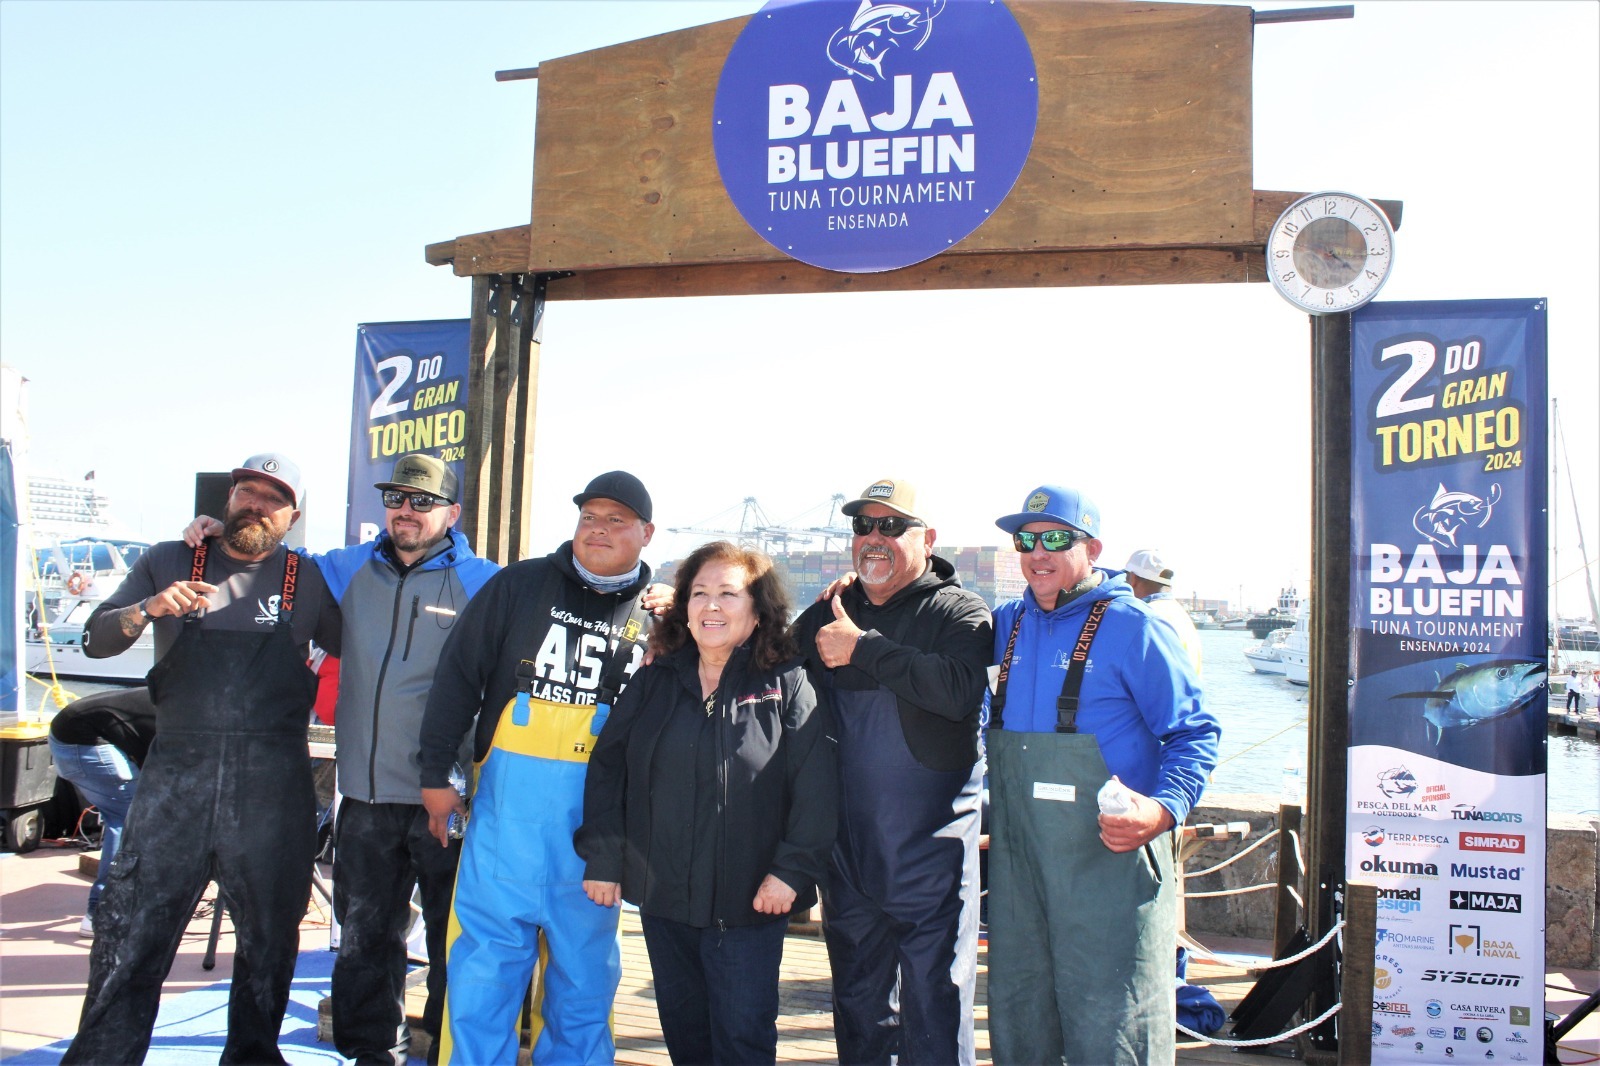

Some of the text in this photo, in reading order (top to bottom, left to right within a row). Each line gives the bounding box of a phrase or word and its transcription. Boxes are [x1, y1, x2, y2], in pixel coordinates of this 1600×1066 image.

[768, 72, 974, 140] BAJA
[767, 134, 975, 184] BLUEFIN
[768, 180, 976, 212] TUNA TOURNAMENT
[1324, 200, 1337, 215] 12
[828, 212, 909, 231] ENSENADA
[1281, 222, 1299, 238] 10
[1365, 269, 1379, 280] 4
[1301, 284, 1312, 299] 7
[1325, 291, 1334, 306] 6
[1347, 284, 1360, 299] 5
[370, 355, 443, 420] 2 DO
[1376, 340, 1481, 419] 2 DO
[413, 380, 460, 411] GRAN
[1442, 371, 1508, 409] GRAN
[369, 409, 466, 460] TORNEO
[1375, 406, 1520, 466] TORNEO
[440, 446, 466, 462] 2024
[1484, 450, 1522, 472] 2024
[1370, 543, 1522, 585] BAJA
[1370, 587, 1523, 617] BLUEFIN
[1370, 620, 1524, 638] TUNA TOURNAMENT
[1400, 640, 1491, 653] ENSENADA 2024
[531, 680, 572, 704] LASS
[1357, 801, 1438, 812] PESCA DEL MAR
[1421, 793, 1451, 803] SPONSORS
[1377, 810, 1417, 818] OUTDOORS
[1451, 810, 1523, 824] TUNABOATS
[1387, 833, 1450, 844] TERRAPESCA
[1464, 836, 1520, 849] SIMRAD
[1360, 855, 1438, 876] okuma
[1451, 863, 1520, 881] Mustad
[1377, 887, 1421, 901] omad
[1471, 894, 1518, 911] MAJA
[1377, 899, 1421, 914] esign
[1483, 940, 1514, 950] BAJA
[1483, 950, 1521, 960] NAVAL
[1375, 954, 1403, 974] GRESO
[1420, 969, 1521, 987] SYSCOM
[1450, 1003, 1506, 1014] CASA RIVERA
